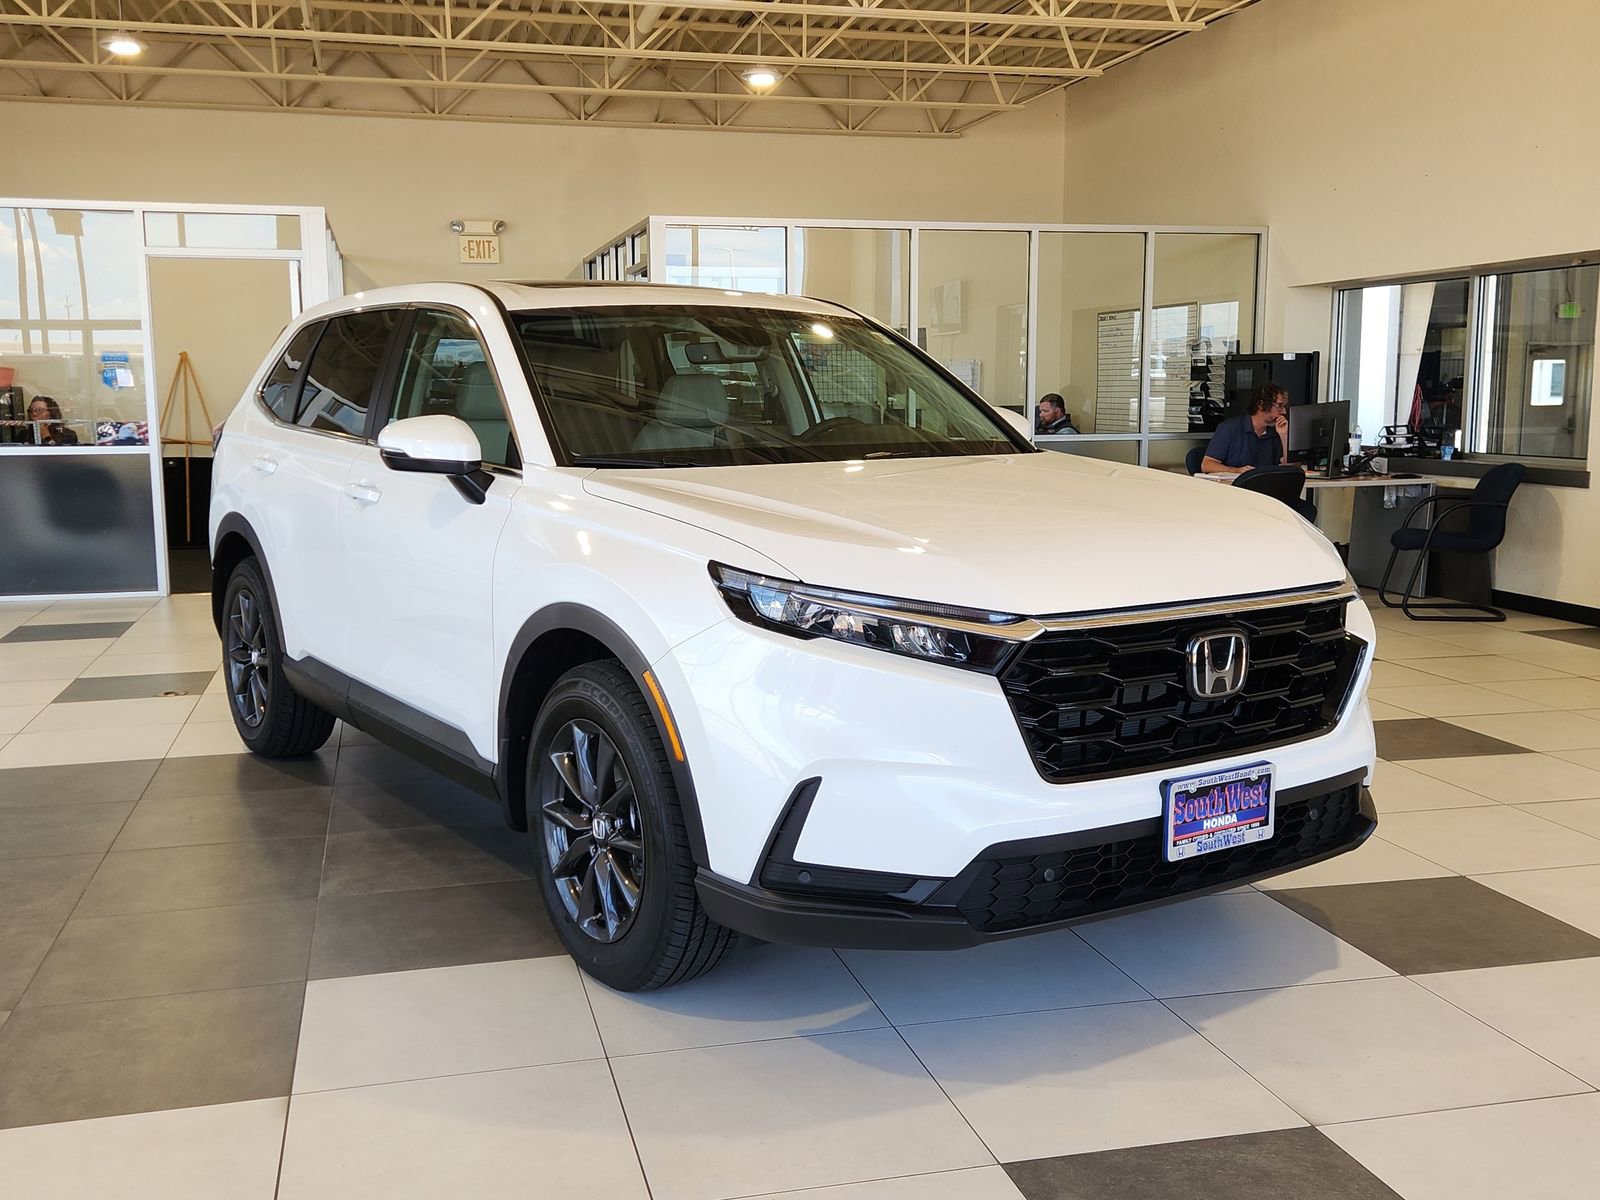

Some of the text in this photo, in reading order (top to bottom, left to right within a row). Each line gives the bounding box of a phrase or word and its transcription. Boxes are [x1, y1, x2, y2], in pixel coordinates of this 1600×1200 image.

[467, 240, 493, 259] EXIT
[1174, 778, 1267, 824] SouthWest
[1203, 813, 1238, 829] HONDA
[1197, 832, 1245, 853] SouthWest
